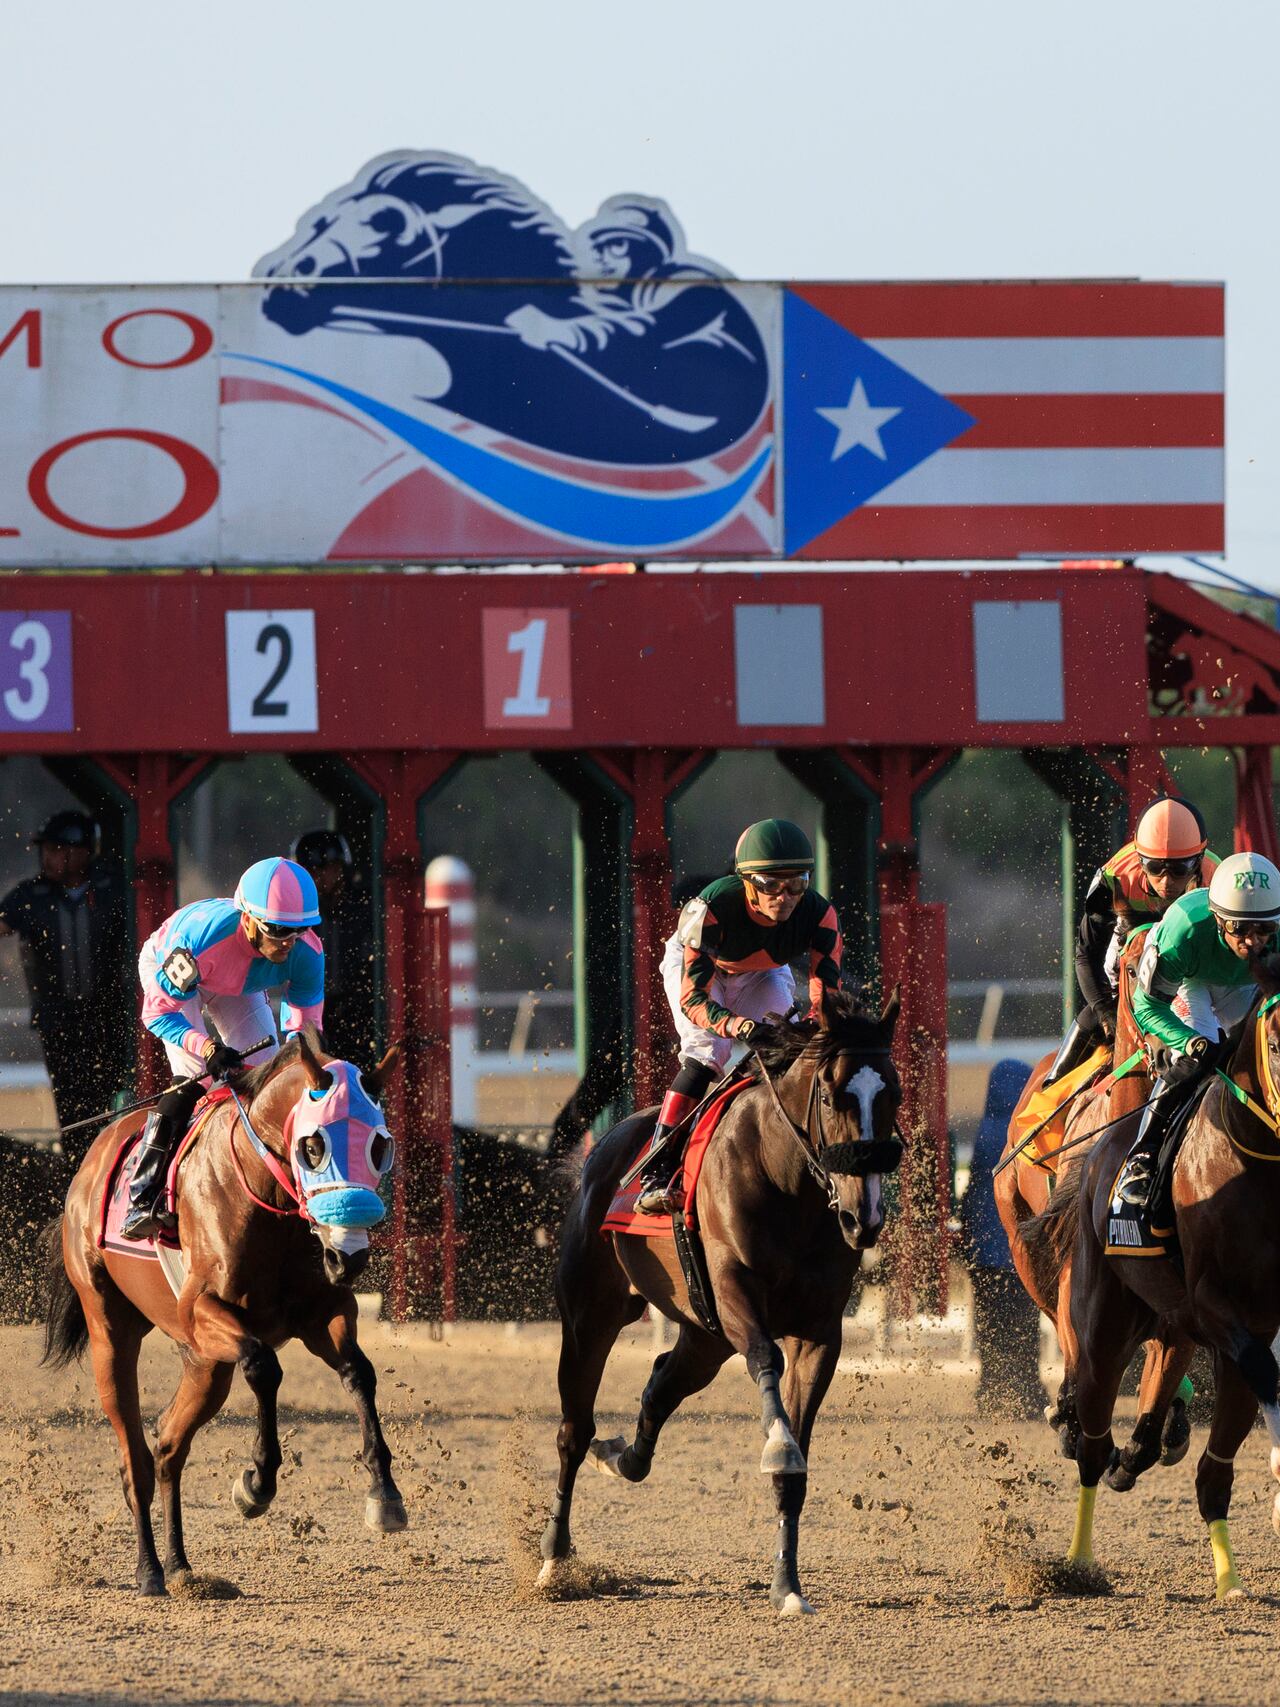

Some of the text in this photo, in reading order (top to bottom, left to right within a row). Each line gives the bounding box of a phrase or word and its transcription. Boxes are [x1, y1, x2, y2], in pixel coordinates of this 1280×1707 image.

[0, 427, 220, 540] O
[3, 619, 52, 721] 3
[251, 622, 293, 717] 2
[502, 618, 550, 717] 1
[680, 899, 706, 938] 7
[1233, 871, 1271, 890] EVR
[166, 953, 194, 989] 8
